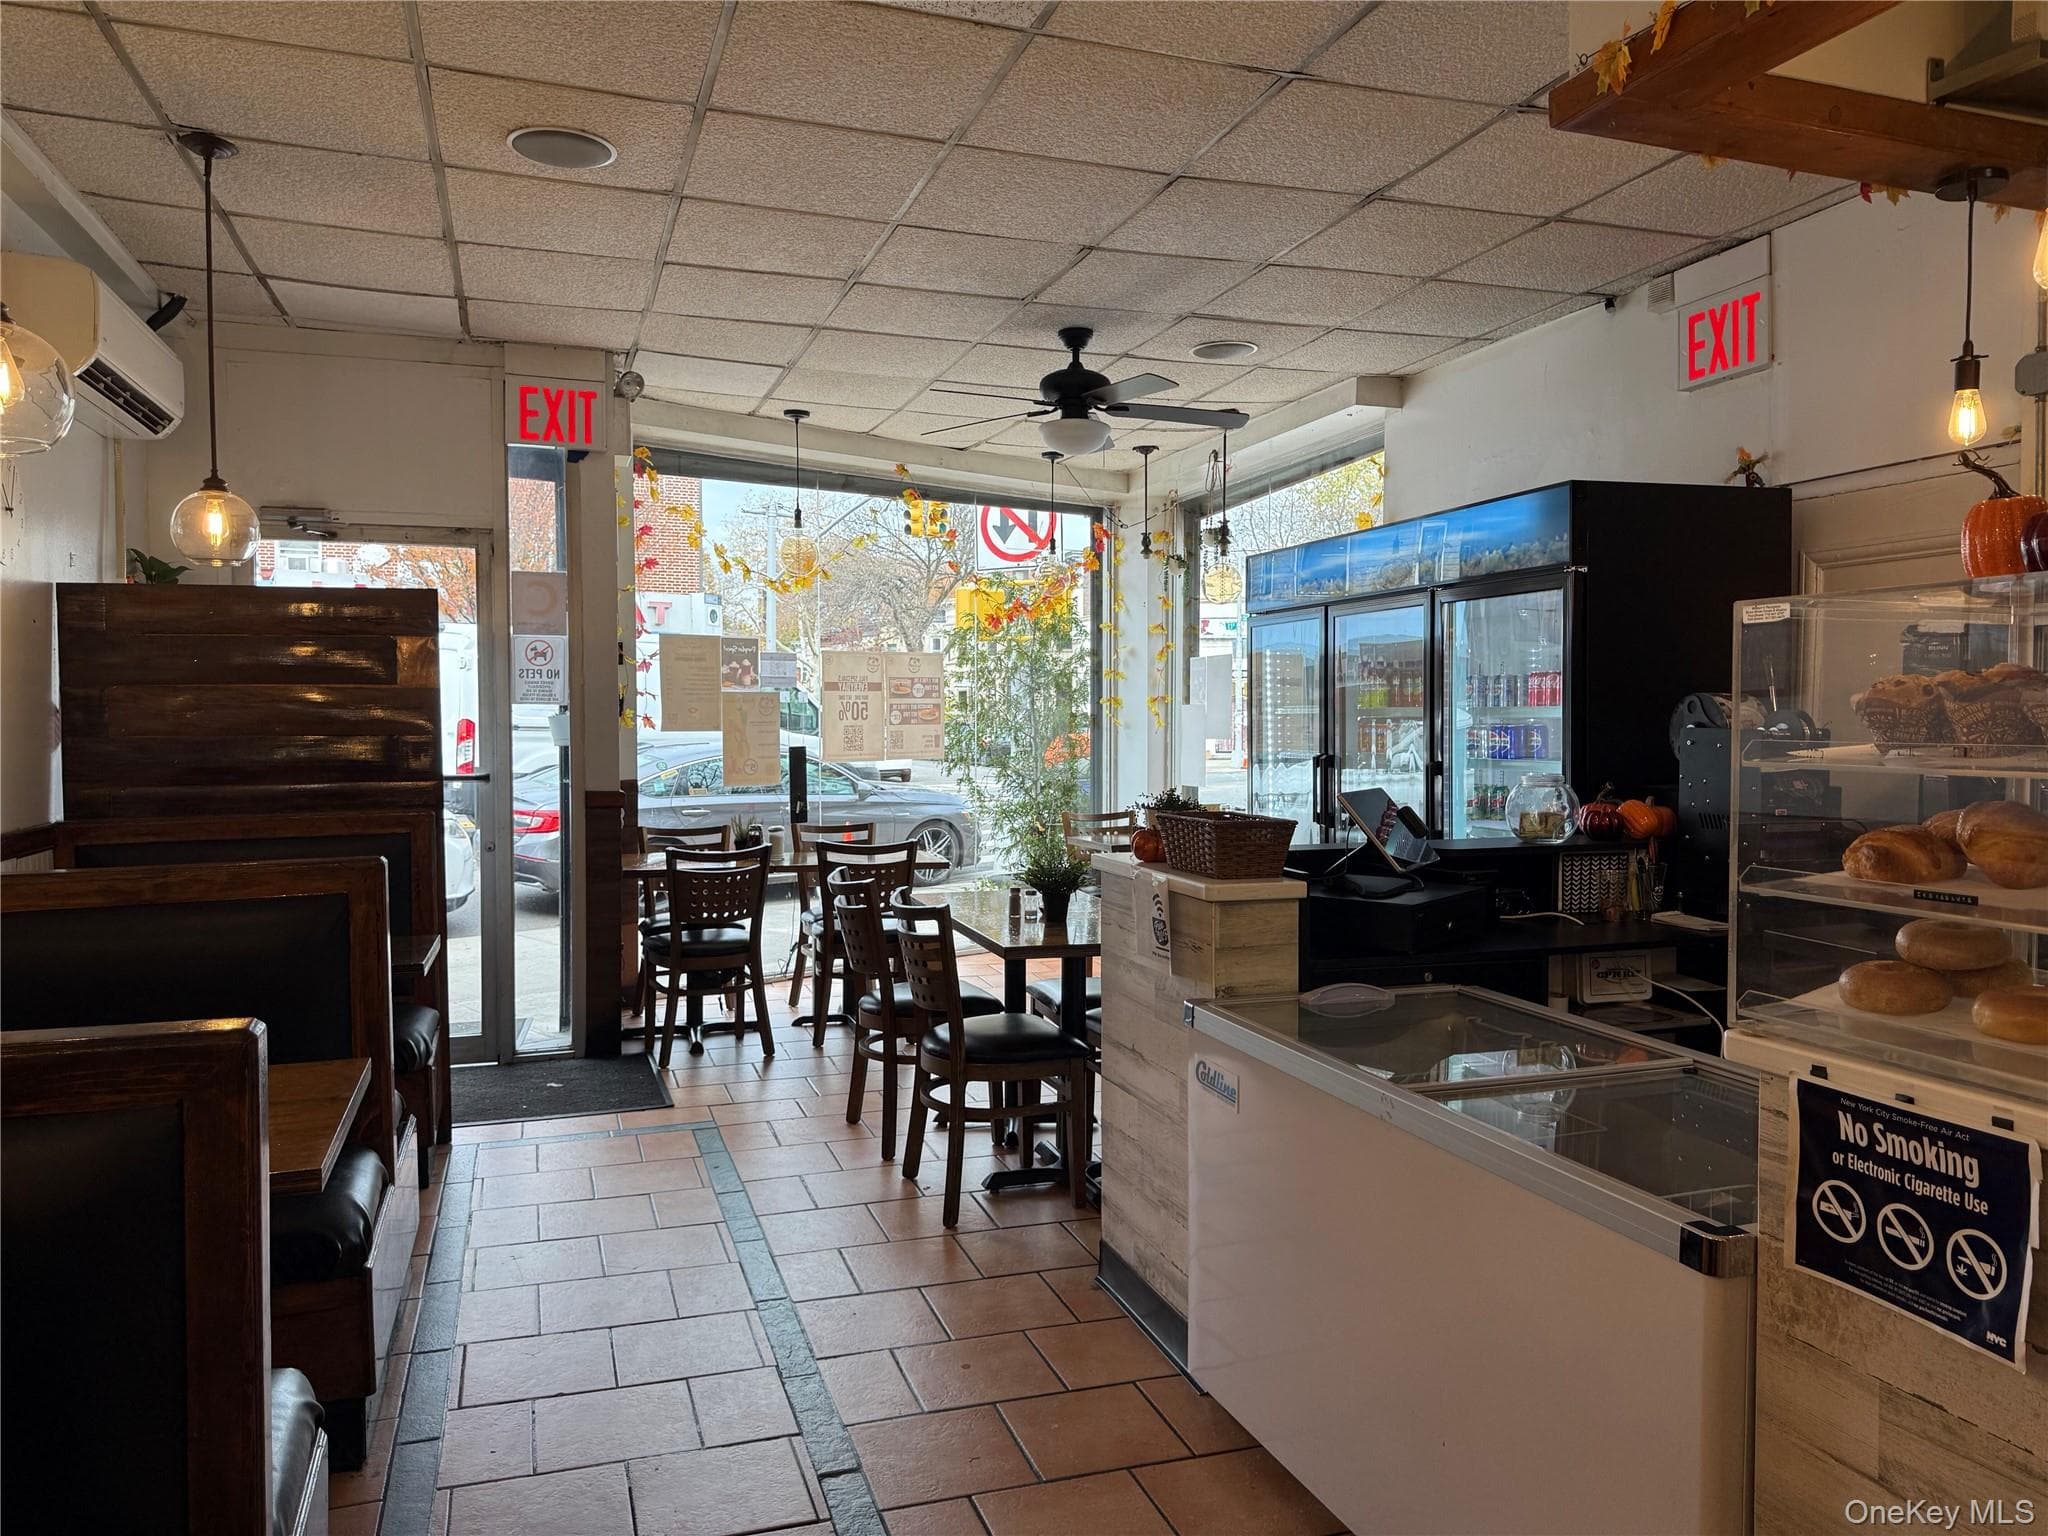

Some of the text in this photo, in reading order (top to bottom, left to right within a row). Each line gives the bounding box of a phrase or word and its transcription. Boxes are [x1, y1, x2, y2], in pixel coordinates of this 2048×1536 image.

[1688, 291, 1761, 381] EXIT
[518, 384, 598, 445] EXIT
[1837, 1110, 1980, 1189] No Smoking
[1840, 1097, 1970, 1142] New York City Smoke-Free Air Act
[1832, 1151, 1989, 1216] or Electronic Cigarette Use
[1985, 1330, 2007, 1348] NYC
